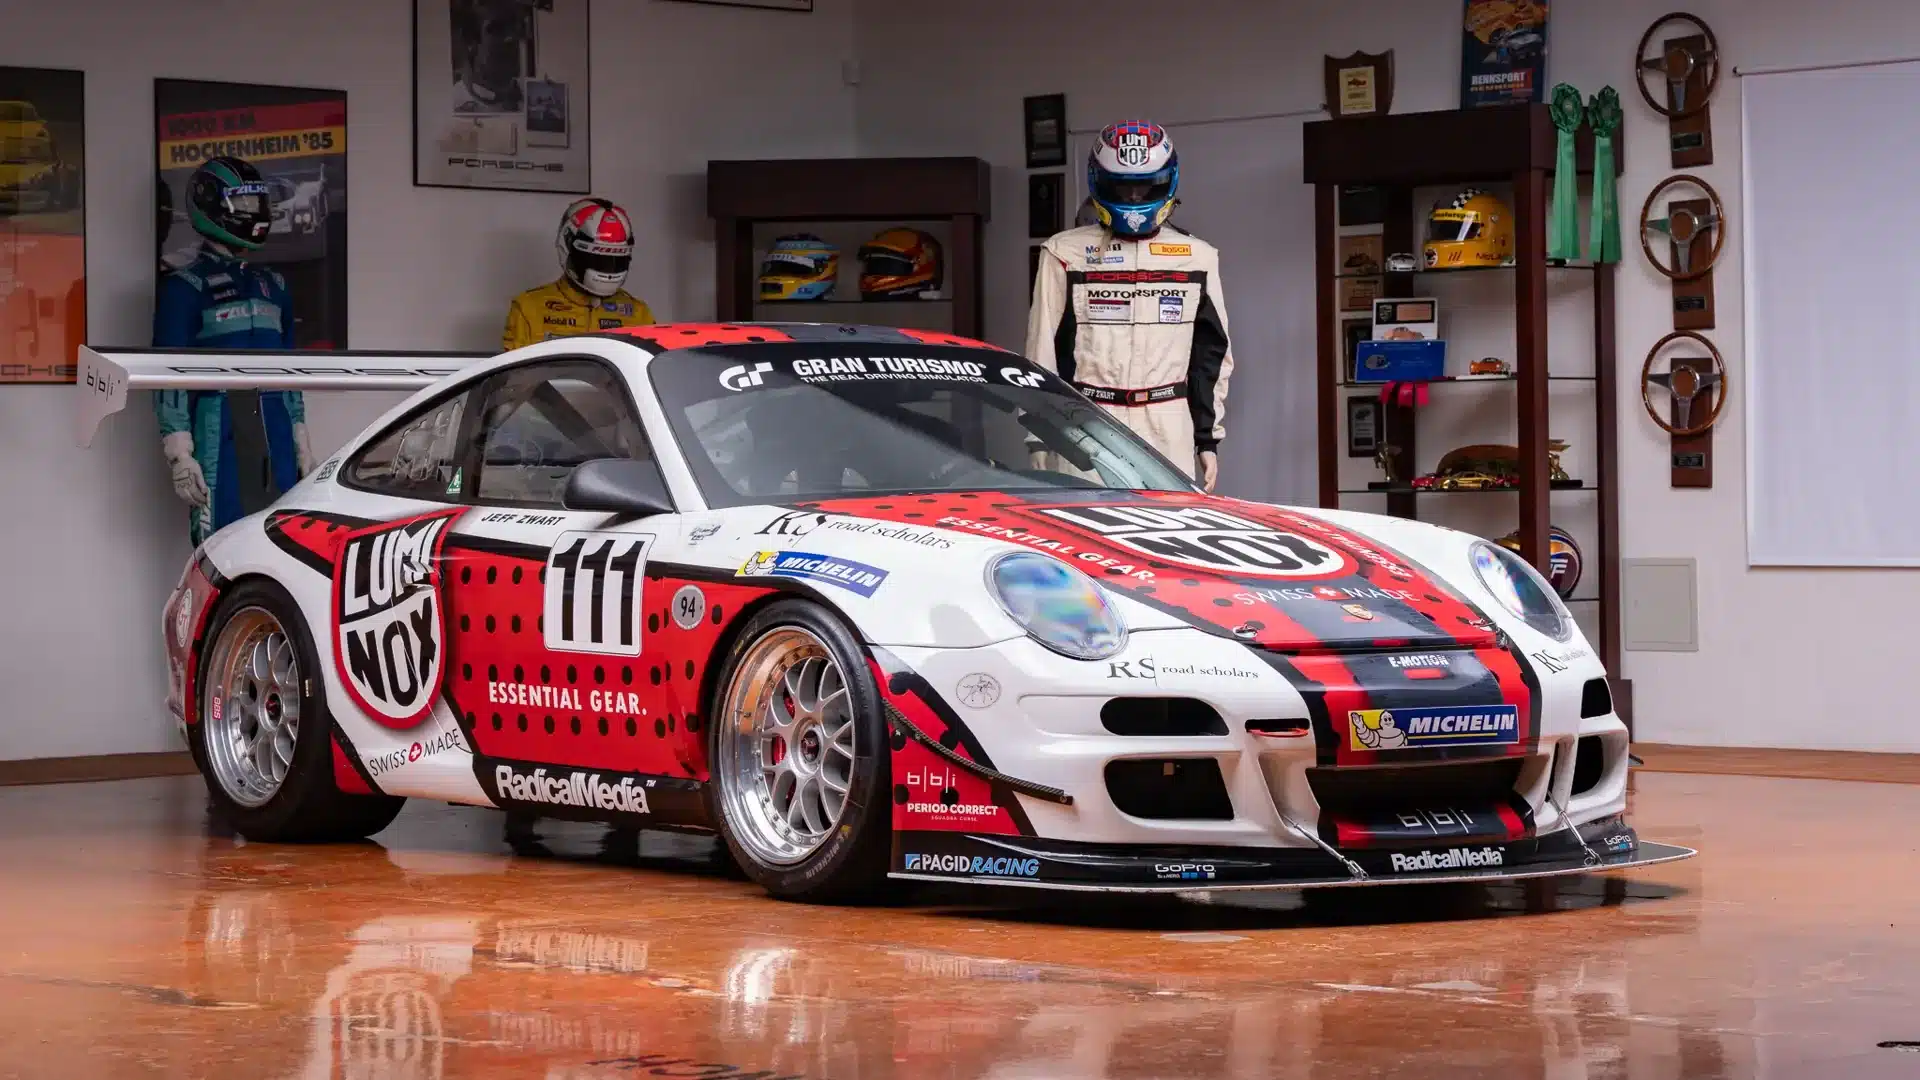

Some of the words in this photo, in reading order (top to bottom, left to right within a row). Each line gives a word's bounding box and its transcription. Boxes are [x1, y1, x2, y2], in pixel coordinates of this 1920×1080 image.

[1471, 71, 1525, 85] RENNSPORT
[170, 136, 300, 163] HOCKENHEIM
[1119, 133, 1148, 146] LUMI
[448, 158, 564, 172] PORSCHE
[1119, 148, 1147, 165] NOX
[1086, 272, 1189, 281] PORSCHE
[1087, 289, 1189, 299] MOTORSPORT
[792, 357, 867, 376] GRAN
[800, 376, 829, 384] THE
[918, 374, 988, 384] SIMULATOR
[1082, 387, 1096, 396] JEFF
[1096, 389, 1115, 400] ZWART
[481, 513, 516, 524] JEFF
[517, 515, 566, 526] ZWART
[1040, 506, 1280, 535] LUMI
[828, 519, 875, 534] road
[872, 525, 957, 550] scholars
[936, 516, 1076, 554] ESSENTIAL
[1078, 552, 1155, 584] GEAR.
[1122, 532, 1332, 571] NOX
[345, 517, 449, 616] LUMI
[778, 556, 882, 588] MICHELIN
[552, 538, 646, 646] 111
[1232, 587, 1316, 606] SWISS
[1341, 587, 1421, 602] MADE
[680, 596, 696, 618] 94
[346, 596, 436, 707] NOX
[1388, 655, 1449, 669] E-MOTION
[1106, 656, 1156, 679] RS
[1162, 664, 1195, 675] road
[1199, 666, 1259, 679] scholars
[213, 697, 221, 719] BBS
[489, 681, 582, 711] ESSENTIAL
[590, 690, 647, 716] GEAR.
[1407, 713, 1515, 734] MICHELIN
[369, 748, 407, 777] SWISS
[423, 727, 461, 757] MADE
[907, 803, 948, 813] PERIOD
[949, 804, 999, 816] CORRECT
